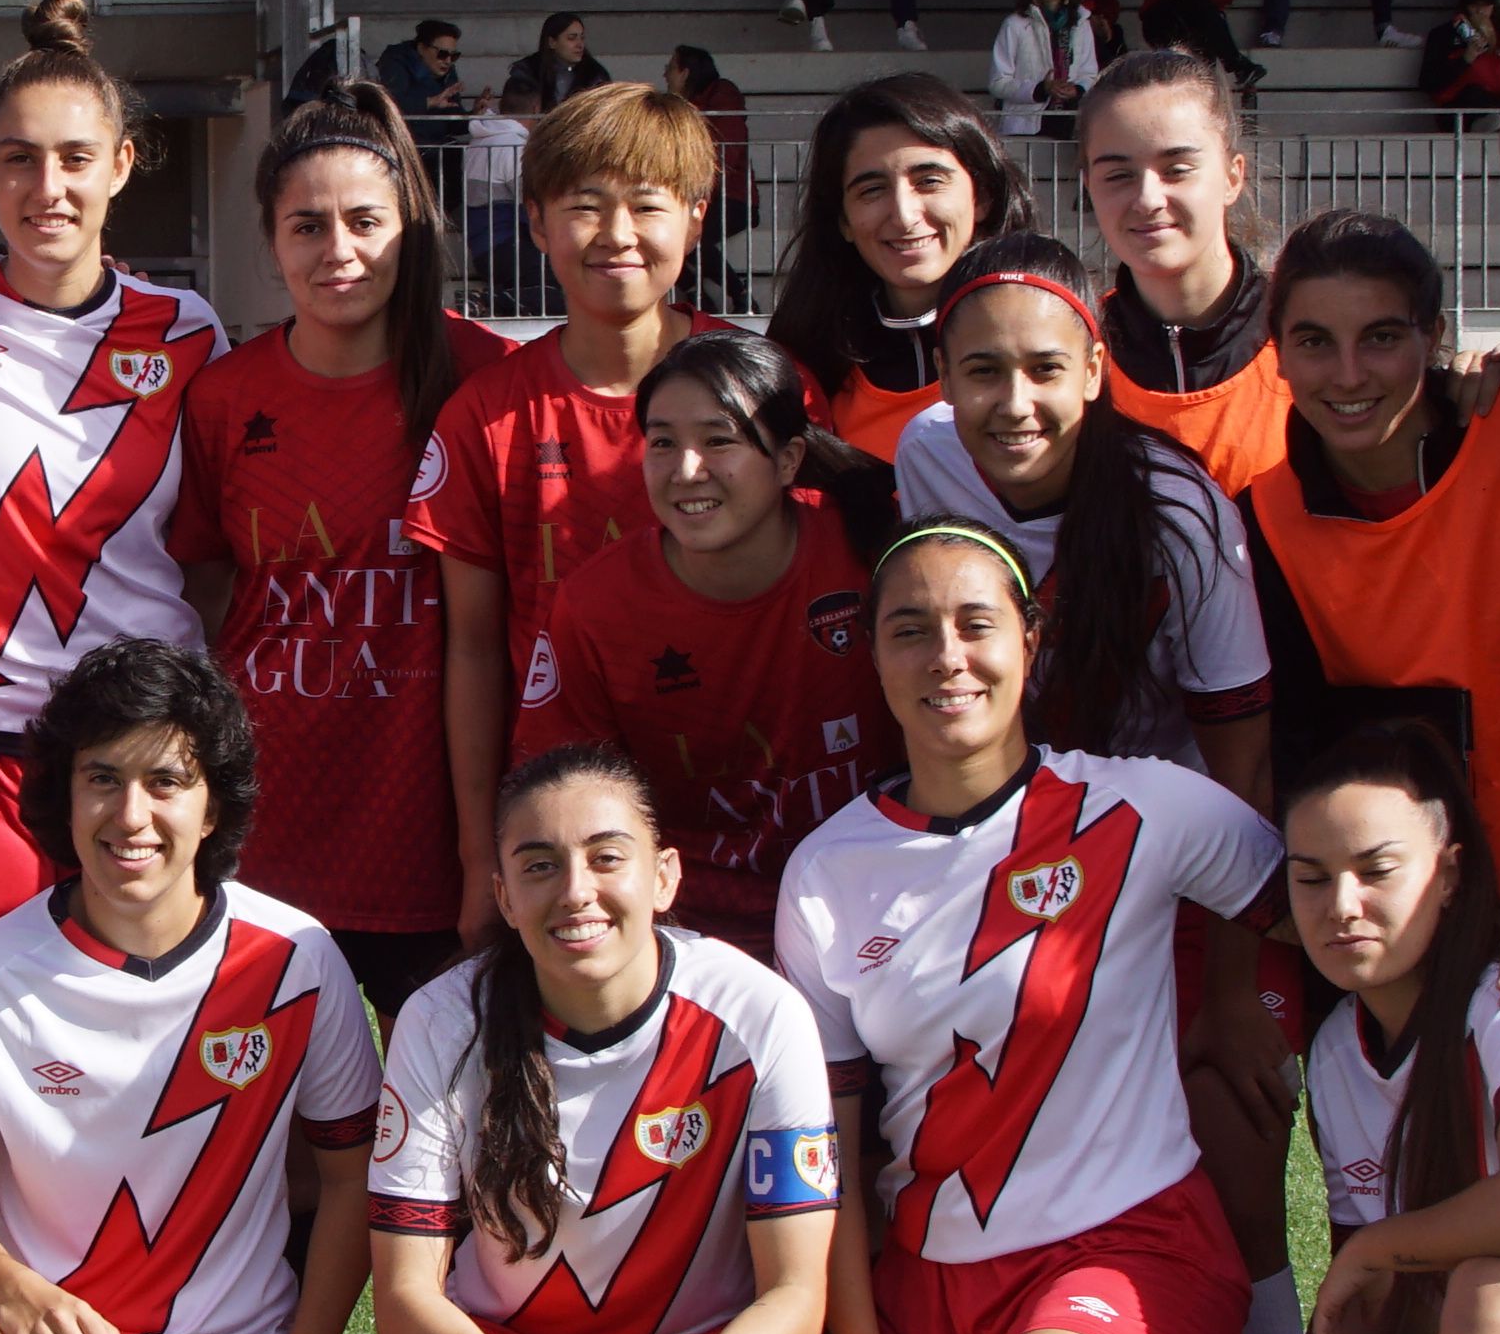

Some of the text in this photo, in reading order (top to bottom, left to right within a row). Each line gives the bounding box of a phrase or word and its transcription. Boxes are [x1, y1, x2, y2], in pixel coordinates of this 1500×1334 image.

[999, 272, 1024, 282] NIKE
[247, 500, 343, 565] LA
[245, 636, 397, 699] GUA
[38, 1084, 80, 1096] umbro
[749, 1137, 774, 1196] C
